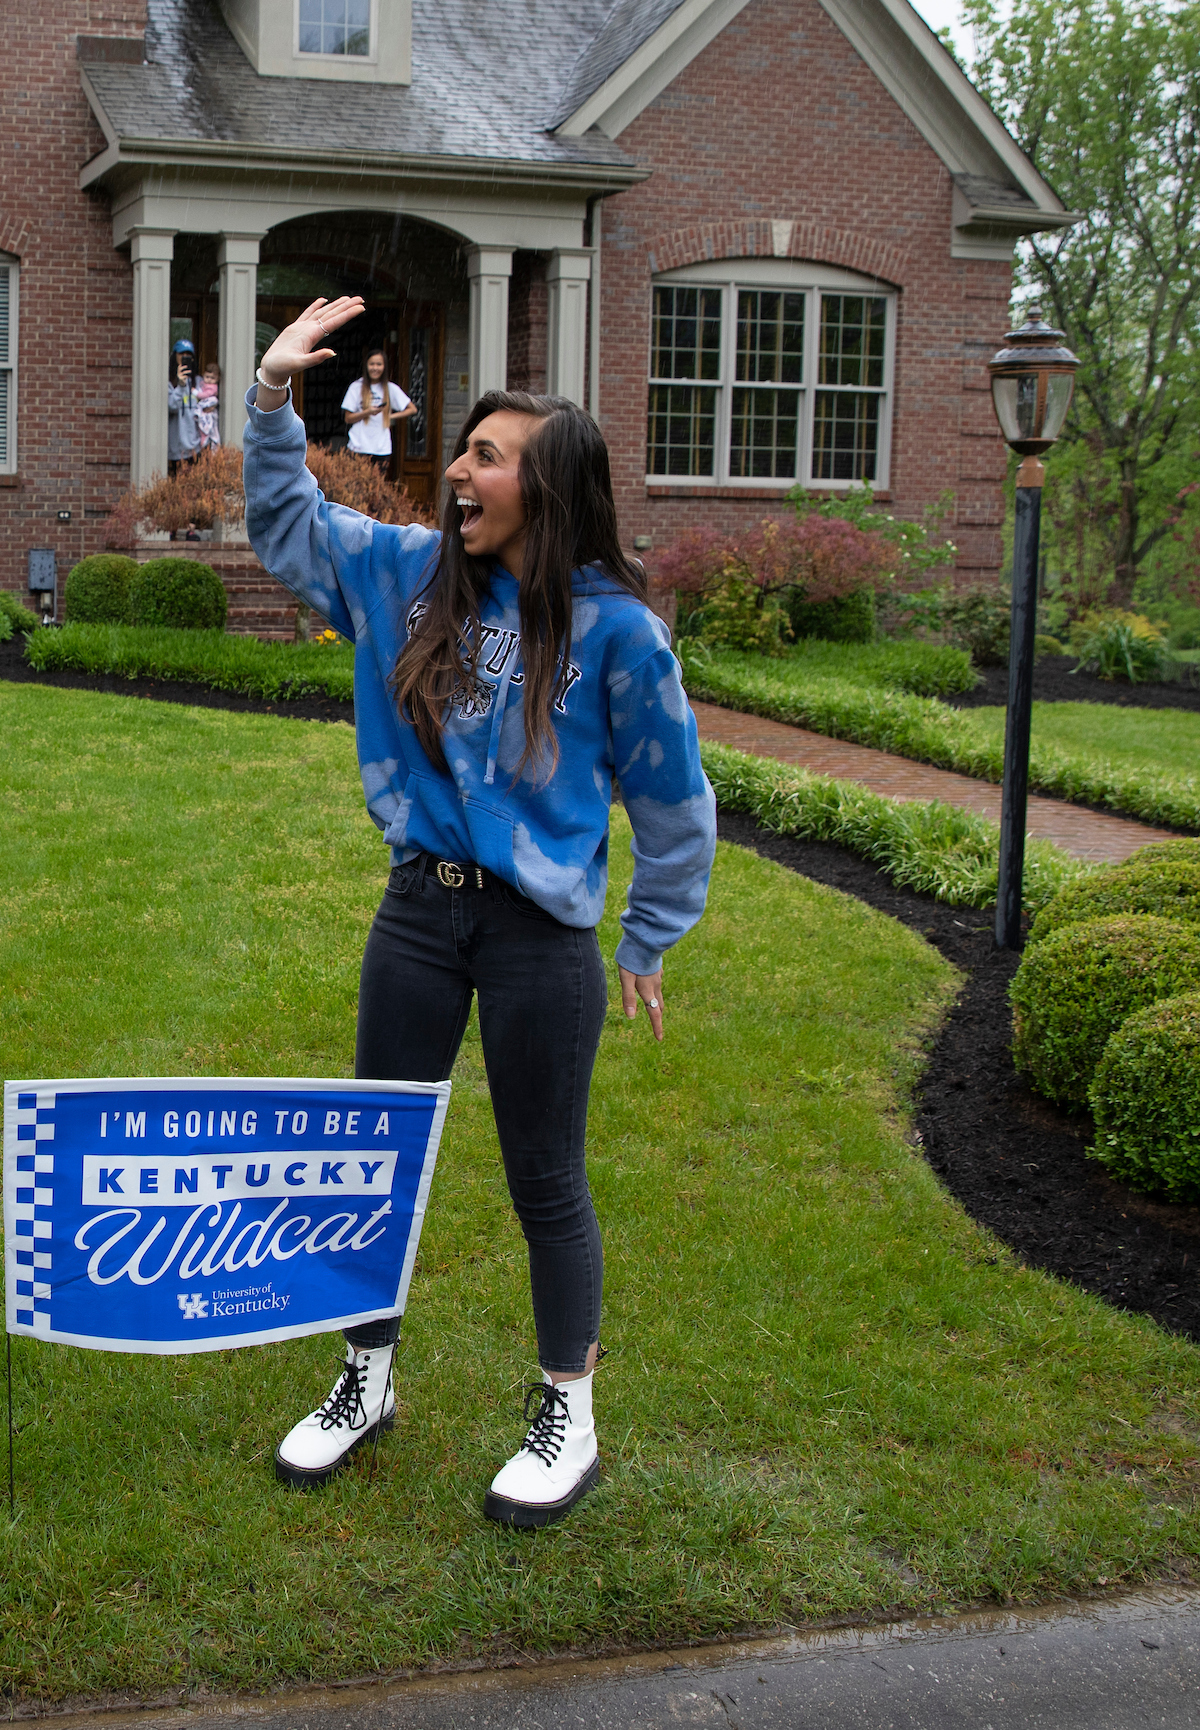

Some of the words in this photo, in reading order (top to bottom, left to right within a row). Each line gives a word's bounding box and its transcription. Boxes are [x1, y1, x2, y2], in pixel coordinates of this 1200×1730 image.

[100, 1111, 147, 1139] I’M
[163, 1110, 258, 1138] GOING
[275, 1110, 309, 1135] TO
[323, 1111, 360, 1136] BE
[373, 1112, 391, 1136] A
[98, 1161, 385, 1194] KENTUCKY
[74, 1198, 392, 1285] Wildcat
[211, 1292, 290, 1317] Kentucky
[212, 1285, 262, 1300] University
[261, 1282, 273, 1294] of
[177, 1293, 209, 1320] UK
